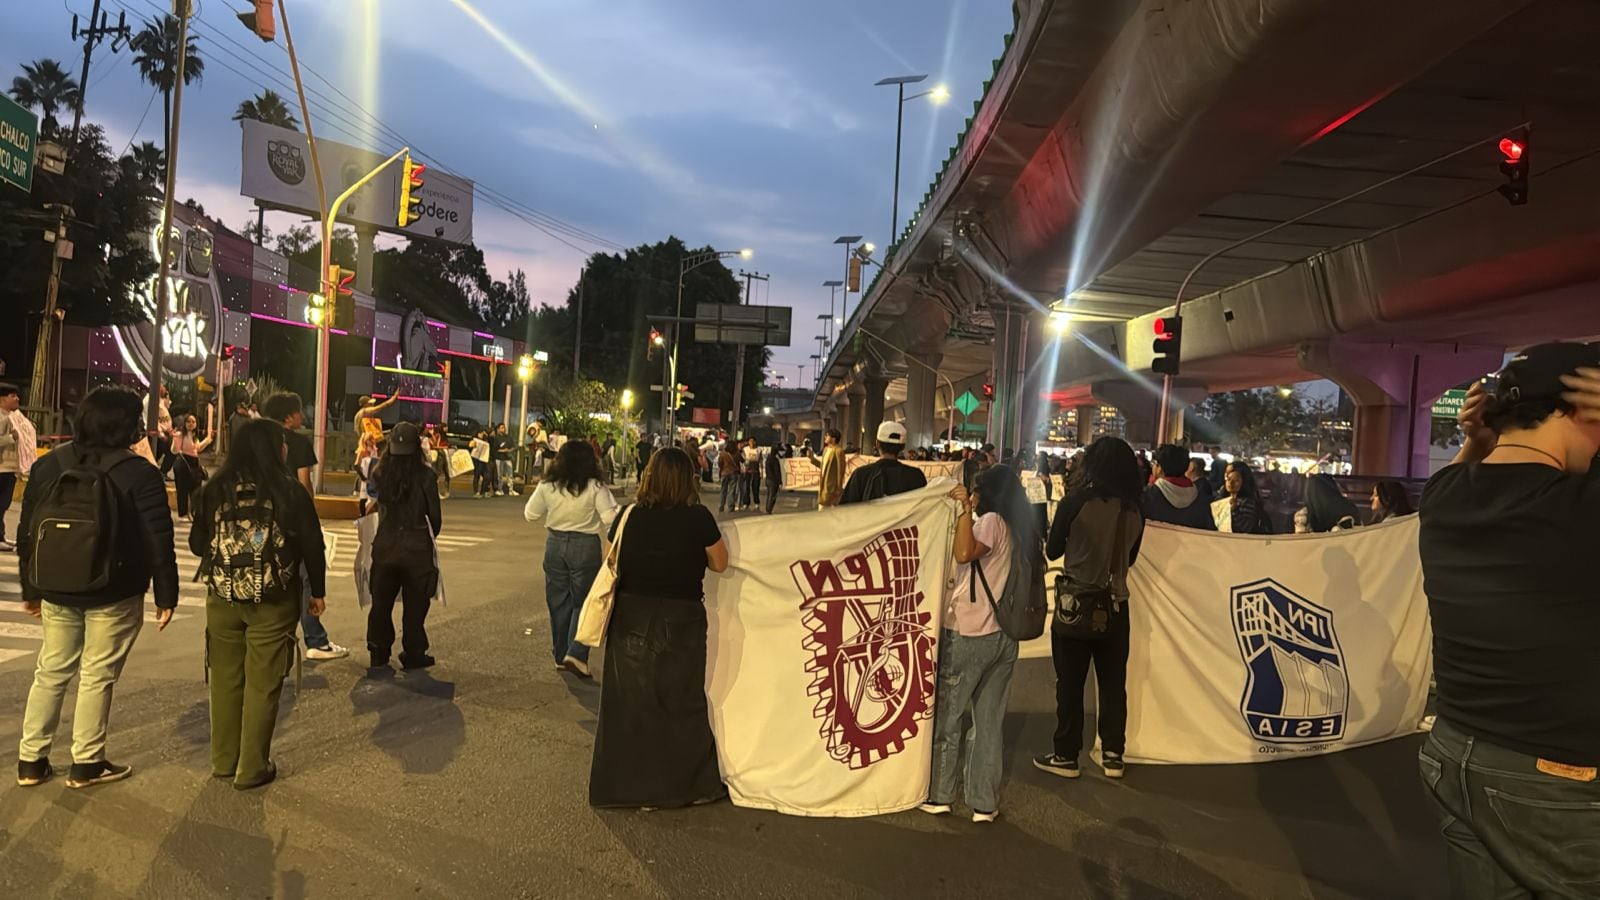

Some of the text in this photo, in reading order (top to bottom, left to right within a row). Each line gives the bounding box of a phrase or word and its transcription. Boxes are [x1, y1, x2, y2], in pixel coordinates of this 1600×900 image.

[1, 120, 30, 153] CHALCO
[0, 148, 28, 179] CO SUR
